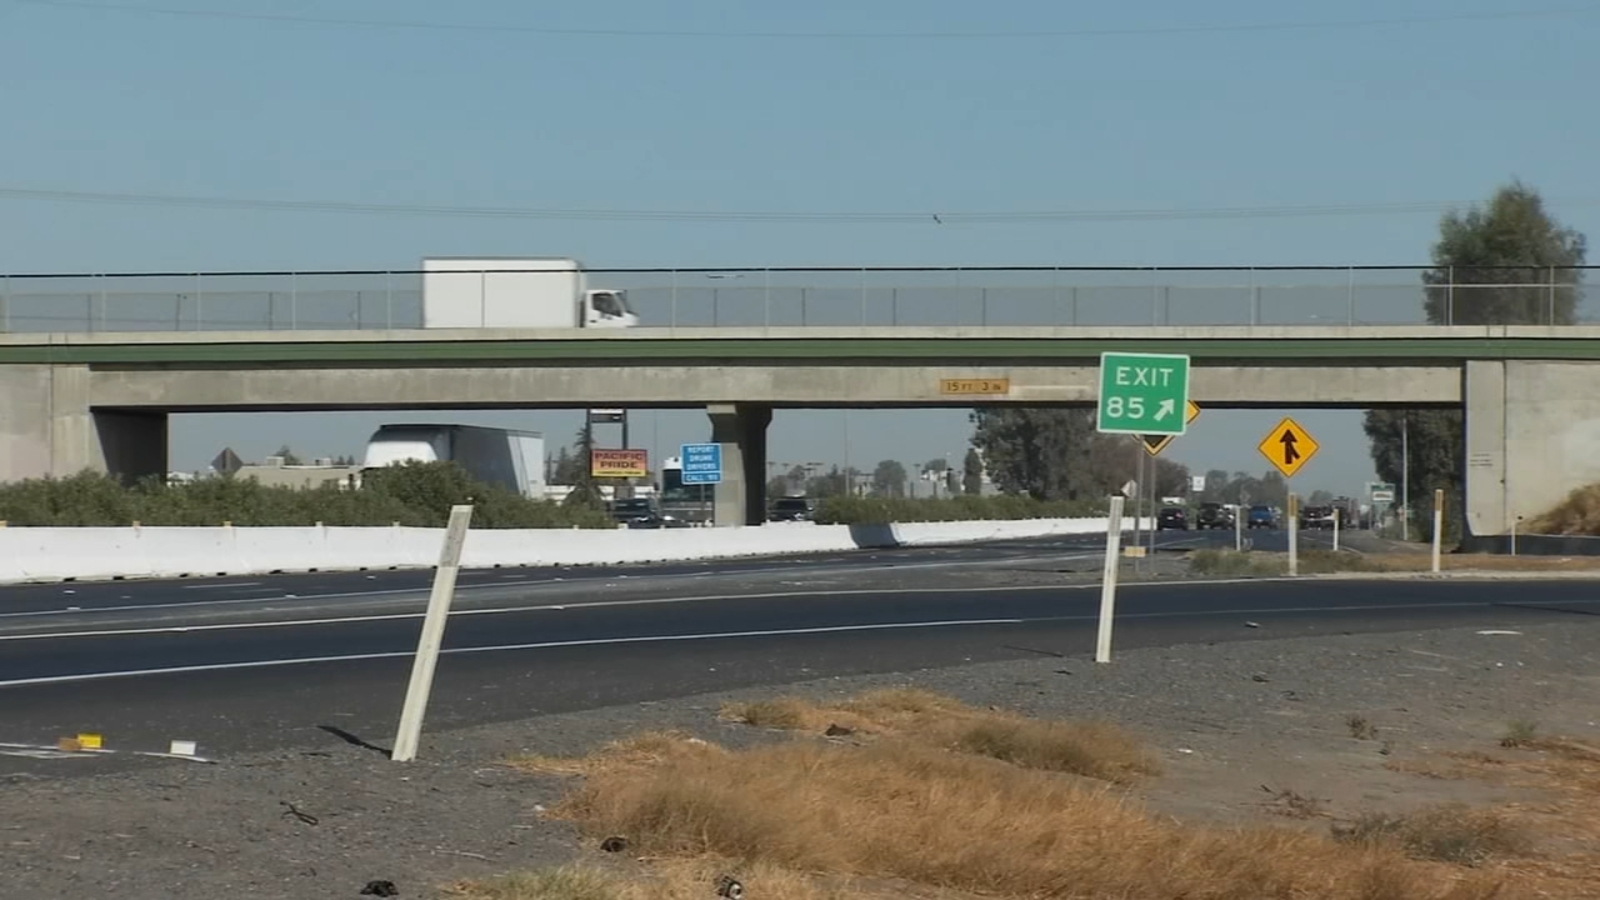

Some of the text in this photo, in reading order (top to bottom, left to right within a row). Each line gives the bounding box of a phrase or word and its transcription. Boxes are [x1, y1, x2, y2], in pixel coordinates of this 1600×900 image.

[946, 382, 959, 391] 15
[982, 382, 989, 391] 3
[1116, 366, 1174, 387] EXIT
[1106, 396, 1145, 419] 85
